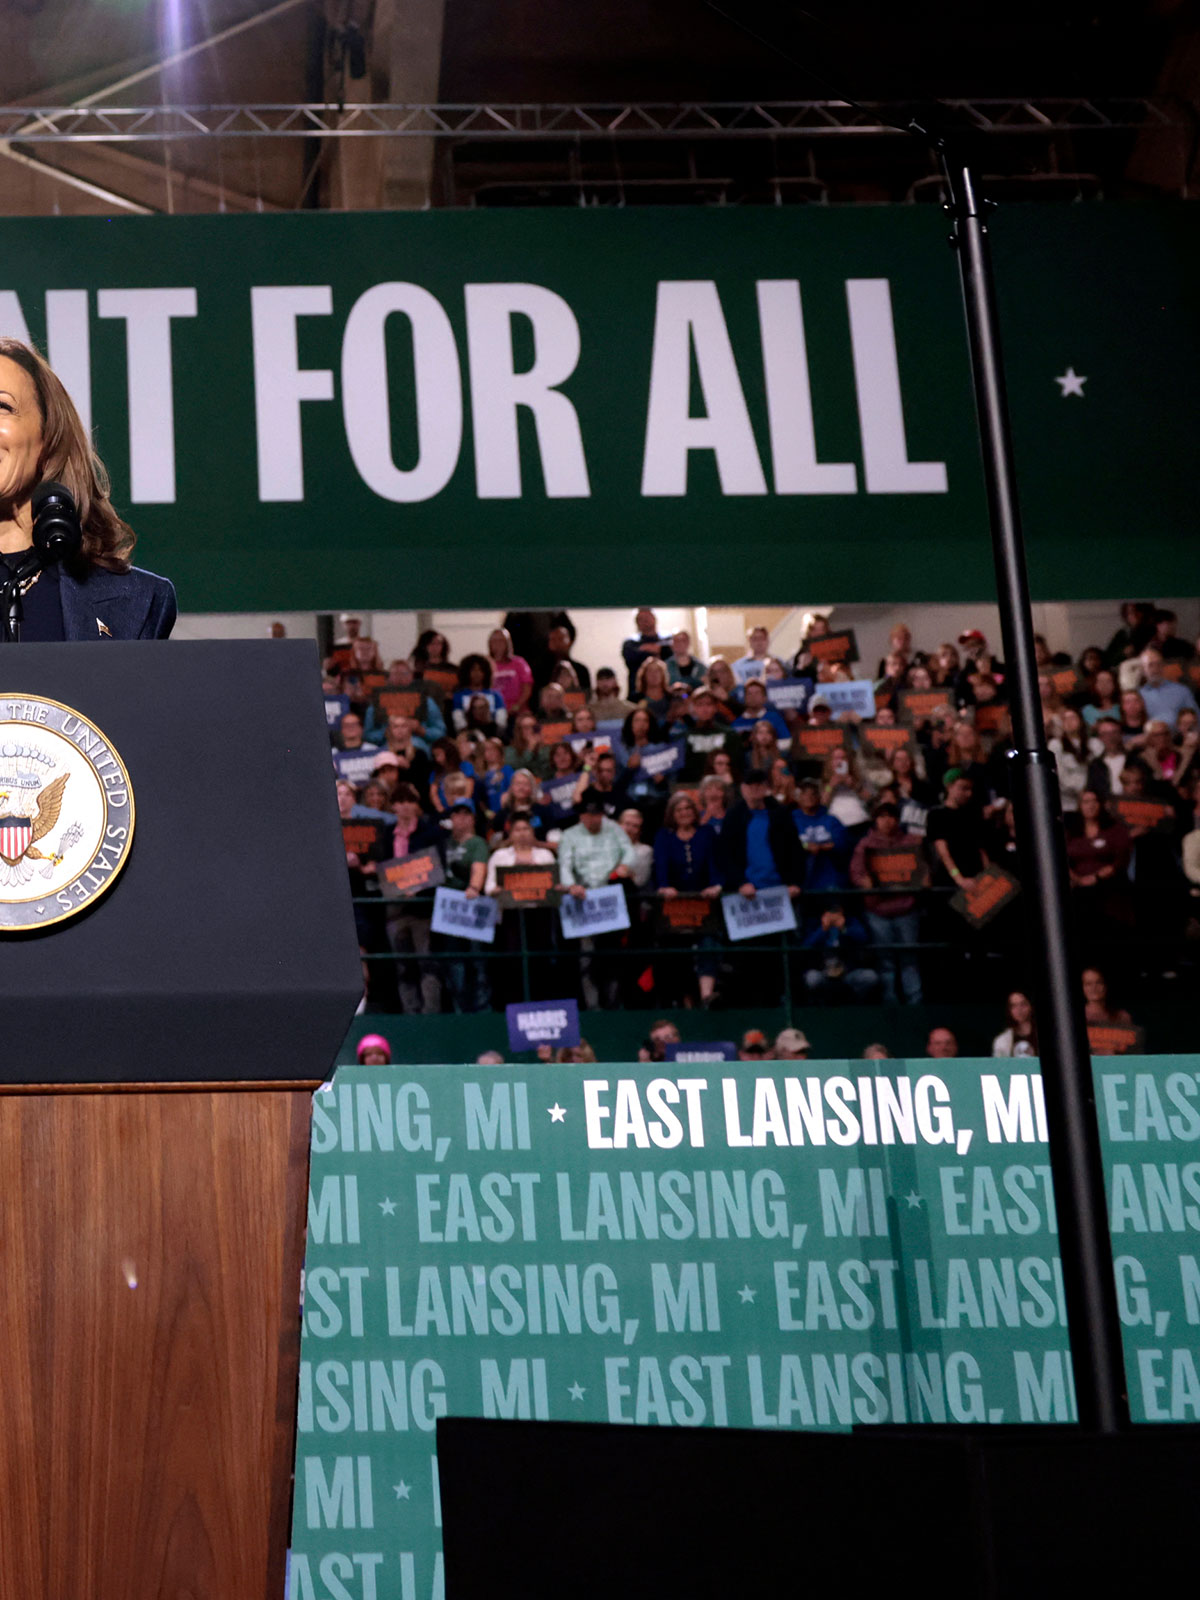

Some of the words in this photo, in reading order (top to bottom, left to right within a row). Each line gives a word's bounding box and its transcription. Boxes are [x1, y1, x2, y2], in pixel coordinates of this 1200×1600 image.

[251, 282, 590, 502] FOR
[641, 279, 947, 496] ALL
[7, 703, 49, 724] THE
[61, 714, 129, 808] UNITED
[56, 824, 127, 912] STATES
[464, 1082, 530, 1150] MI
[584, 1079, 707, 1148] EAST
[722, 1075, 973, 1154] LANSING,
[981, 1074, 1048, 1143] MI
[416, 1172, 540, 1242] EAST
[556, 1169, 807, 1248] LANSING,
[818, 1167, 887, 1237] MI
[302, 1267, 369, 1338] ST
[385, 1263, 639, 1345] LANSING,
[651, 1262, 720, 1332] MI
[774, 1259, 896, 1331] EAST
[480, 1359, 549, 1419] MI
[604, 1355, 731, 1426] EAST
[305, 1456, 373, 1529] MI
